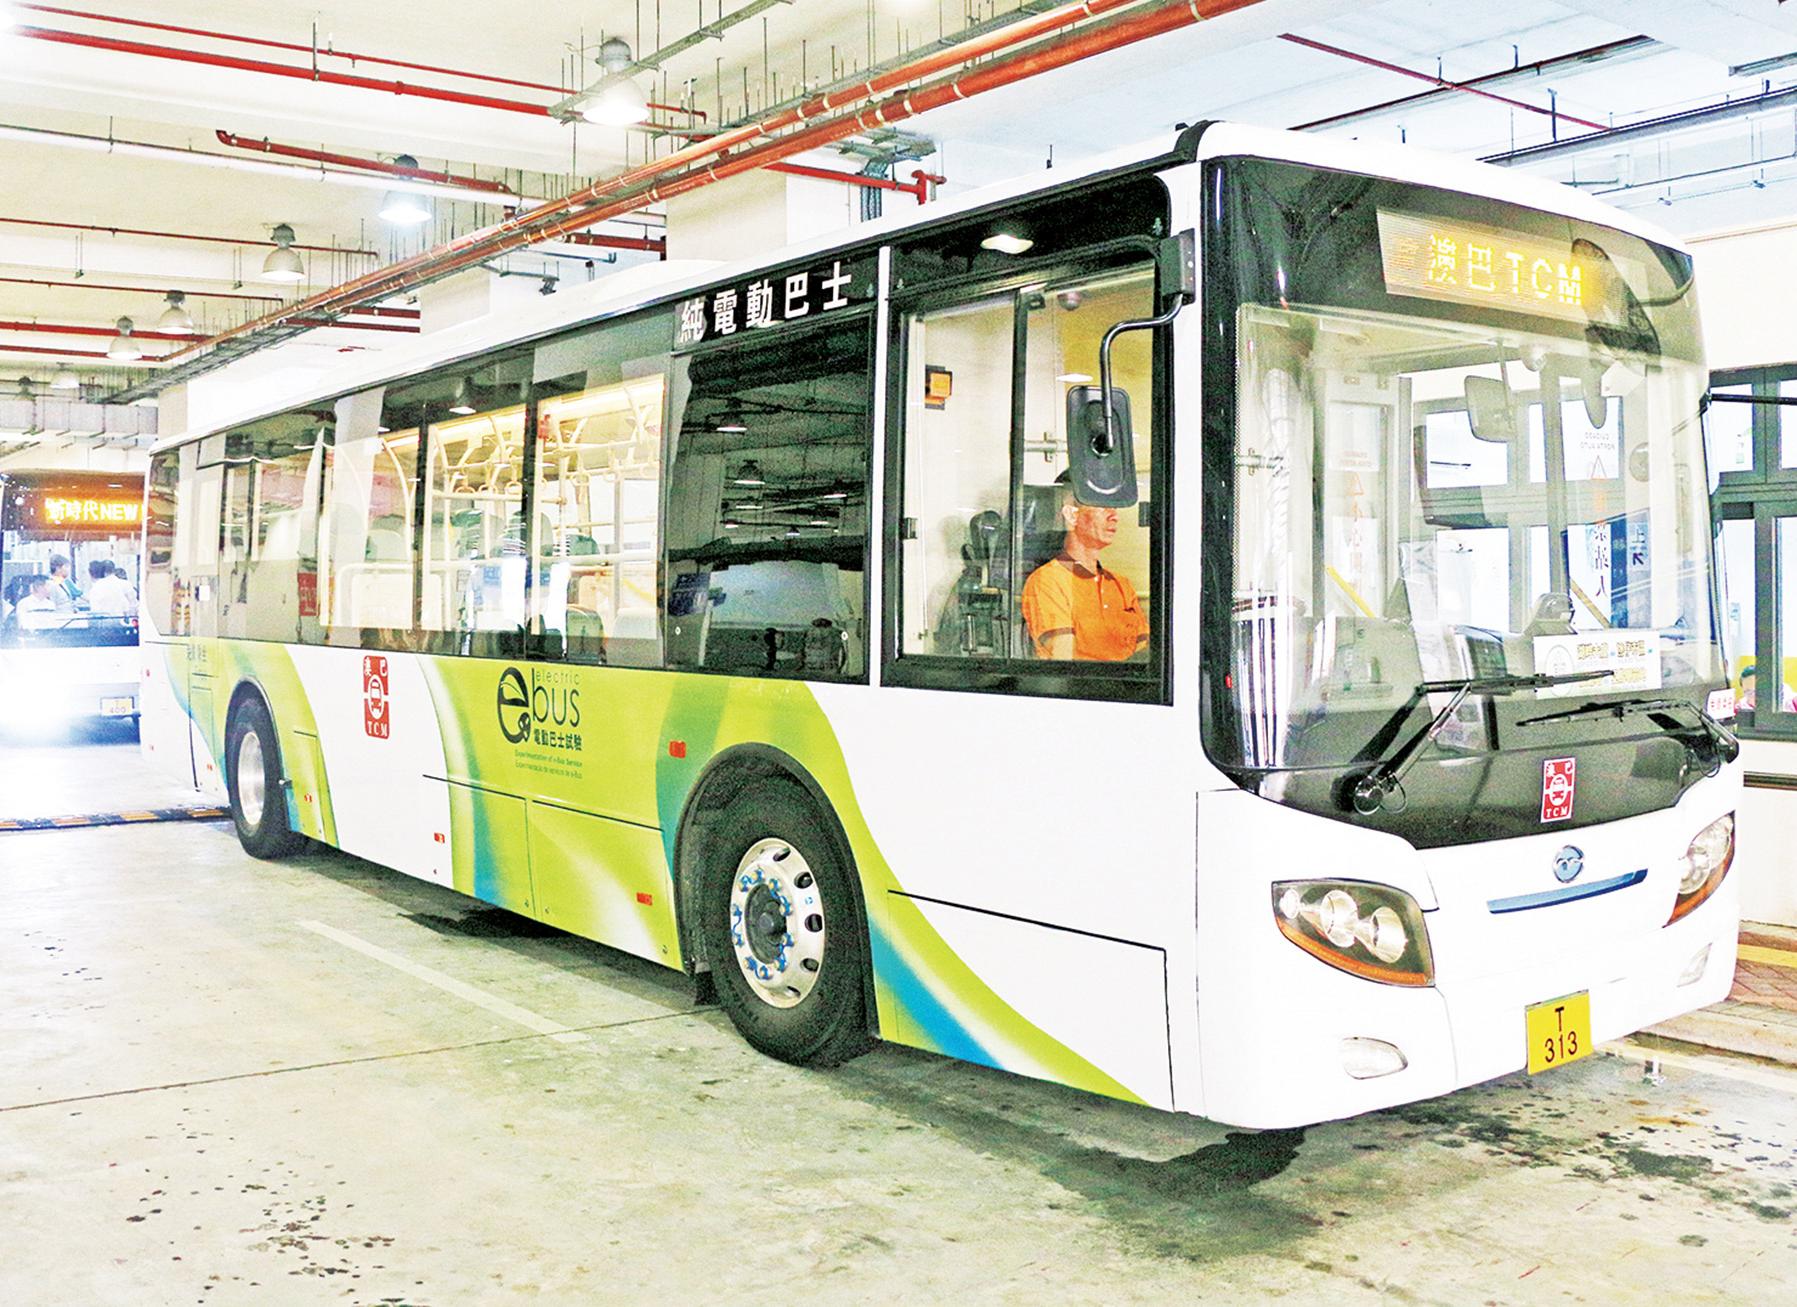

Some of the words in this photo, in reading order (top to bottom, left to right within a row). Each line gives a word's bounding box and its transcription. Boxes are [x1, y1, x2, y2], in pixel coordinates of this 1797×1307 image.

[679, 261, 852, 344] 純電動巴士
[535, 669, 580, 685] electric
[367, 720, 388, 737] TCM
[1546, 806, 1568, 818] TCM
[1555, 1006, 1565, 1032] T
[1545, 1030, 1578, 1063] 313
